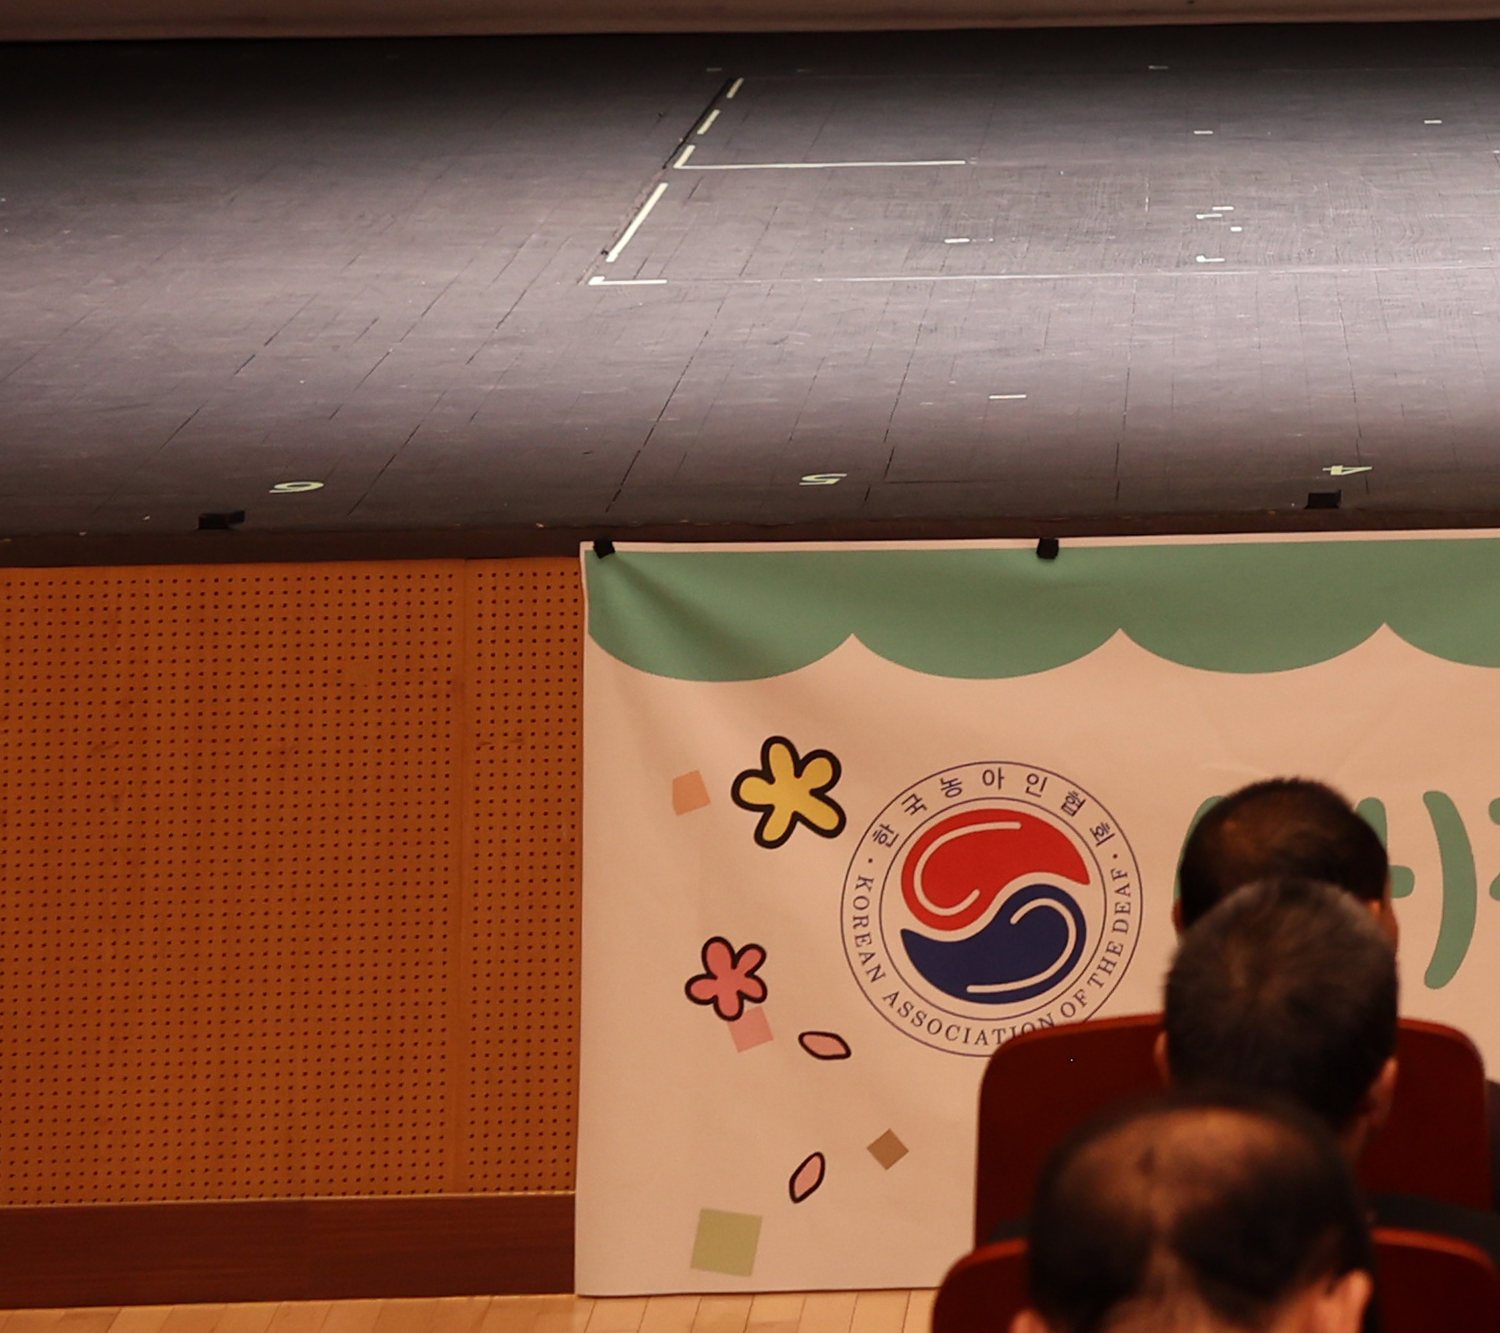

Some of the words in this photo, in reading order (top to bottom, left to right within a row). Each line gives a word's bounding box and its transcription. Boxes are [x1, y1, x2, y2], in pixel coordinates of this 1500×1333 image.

[871, 766, 1116, 849] 한국농아인협회
[851, 874, 887, 984] KOREAN
[1059, 989, 1088, 1019] OF
[1086, 940, 1125, 991] THE
[1110, 867, 1132, 936] DEAF
